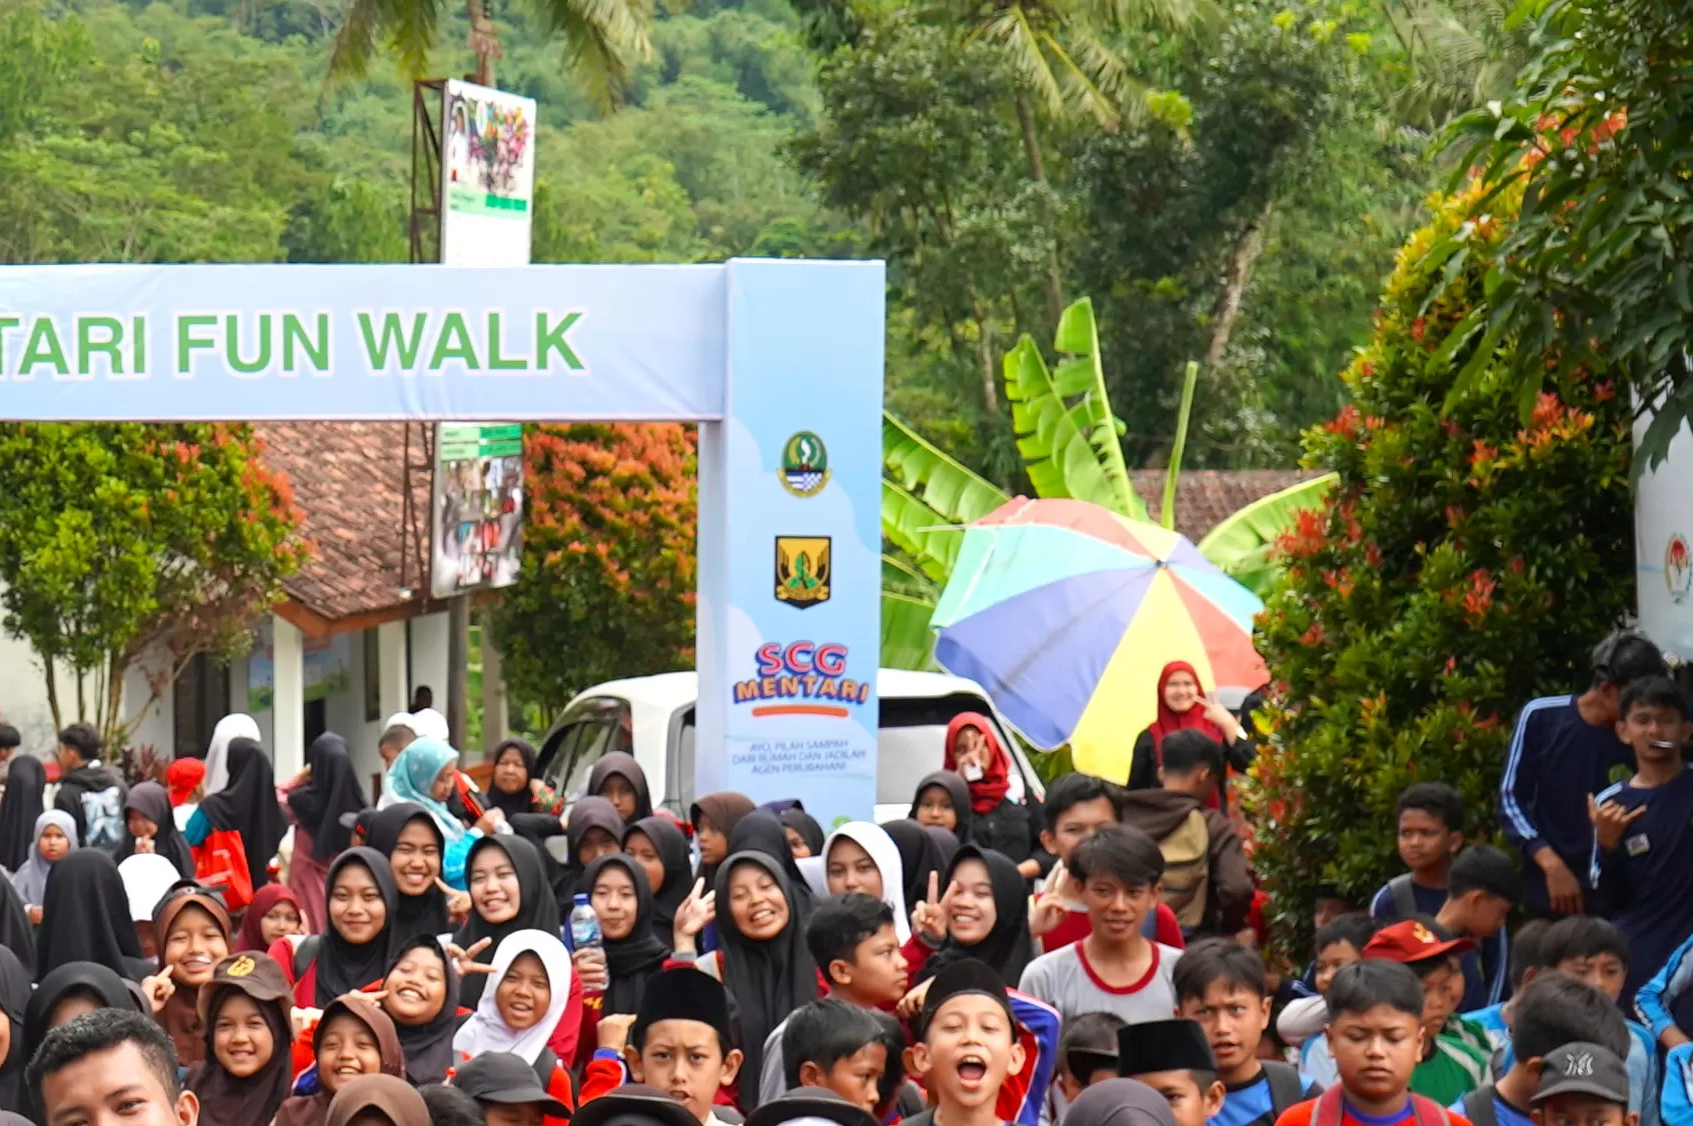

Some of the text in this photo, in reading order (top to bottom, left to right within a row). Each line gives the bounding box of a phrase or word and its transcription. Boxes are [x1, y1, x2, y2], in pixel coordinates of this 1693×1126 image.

[177, 314, 329, 374] FUN
[356, 312, 586, 371] WALK
[755, 640, 849, 678] SCG
[732, 674, 870, 705] MENTARI
